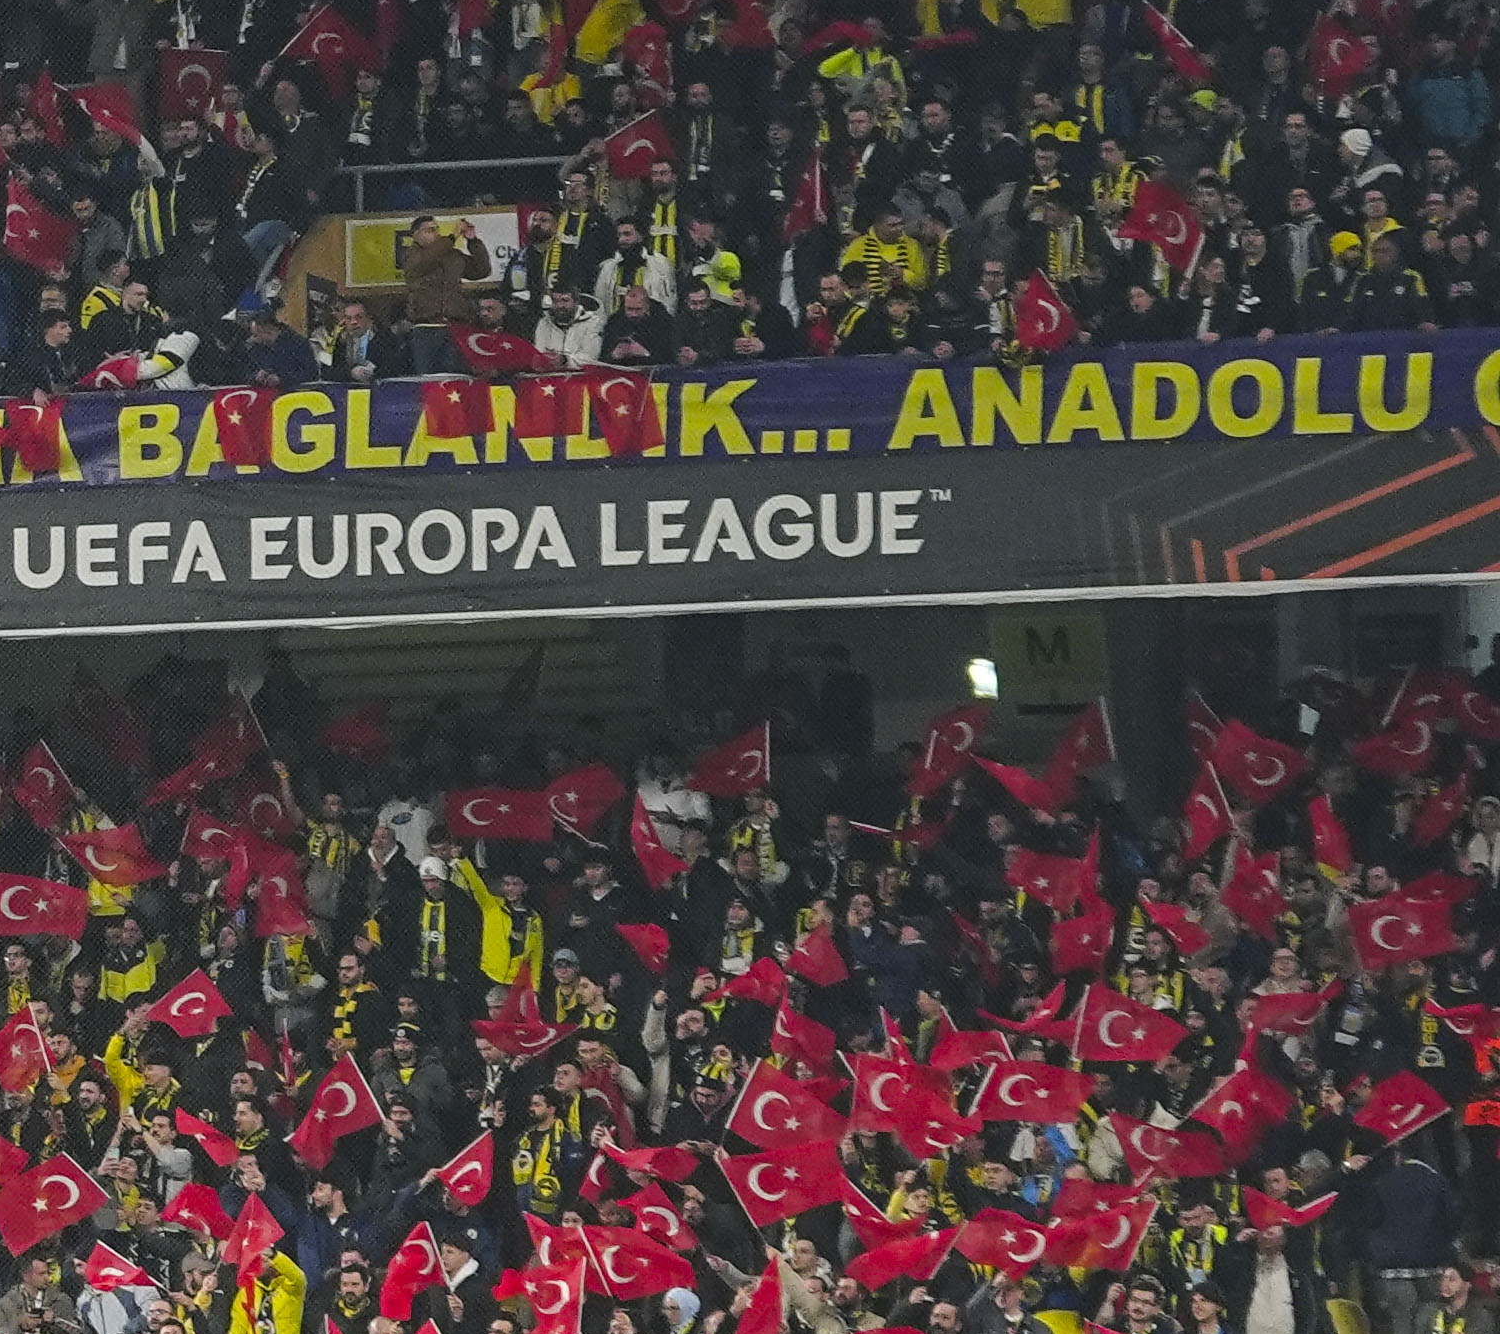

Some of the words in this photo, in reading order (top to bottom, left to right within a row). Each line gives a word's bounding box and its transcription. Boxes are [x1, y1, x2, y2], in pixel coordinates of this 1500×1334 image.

[887, 352, 1434, 451] ANADOLU
[10, 519, 228, 590] UEFA
[248, 504, 577, 581] EUROPA
